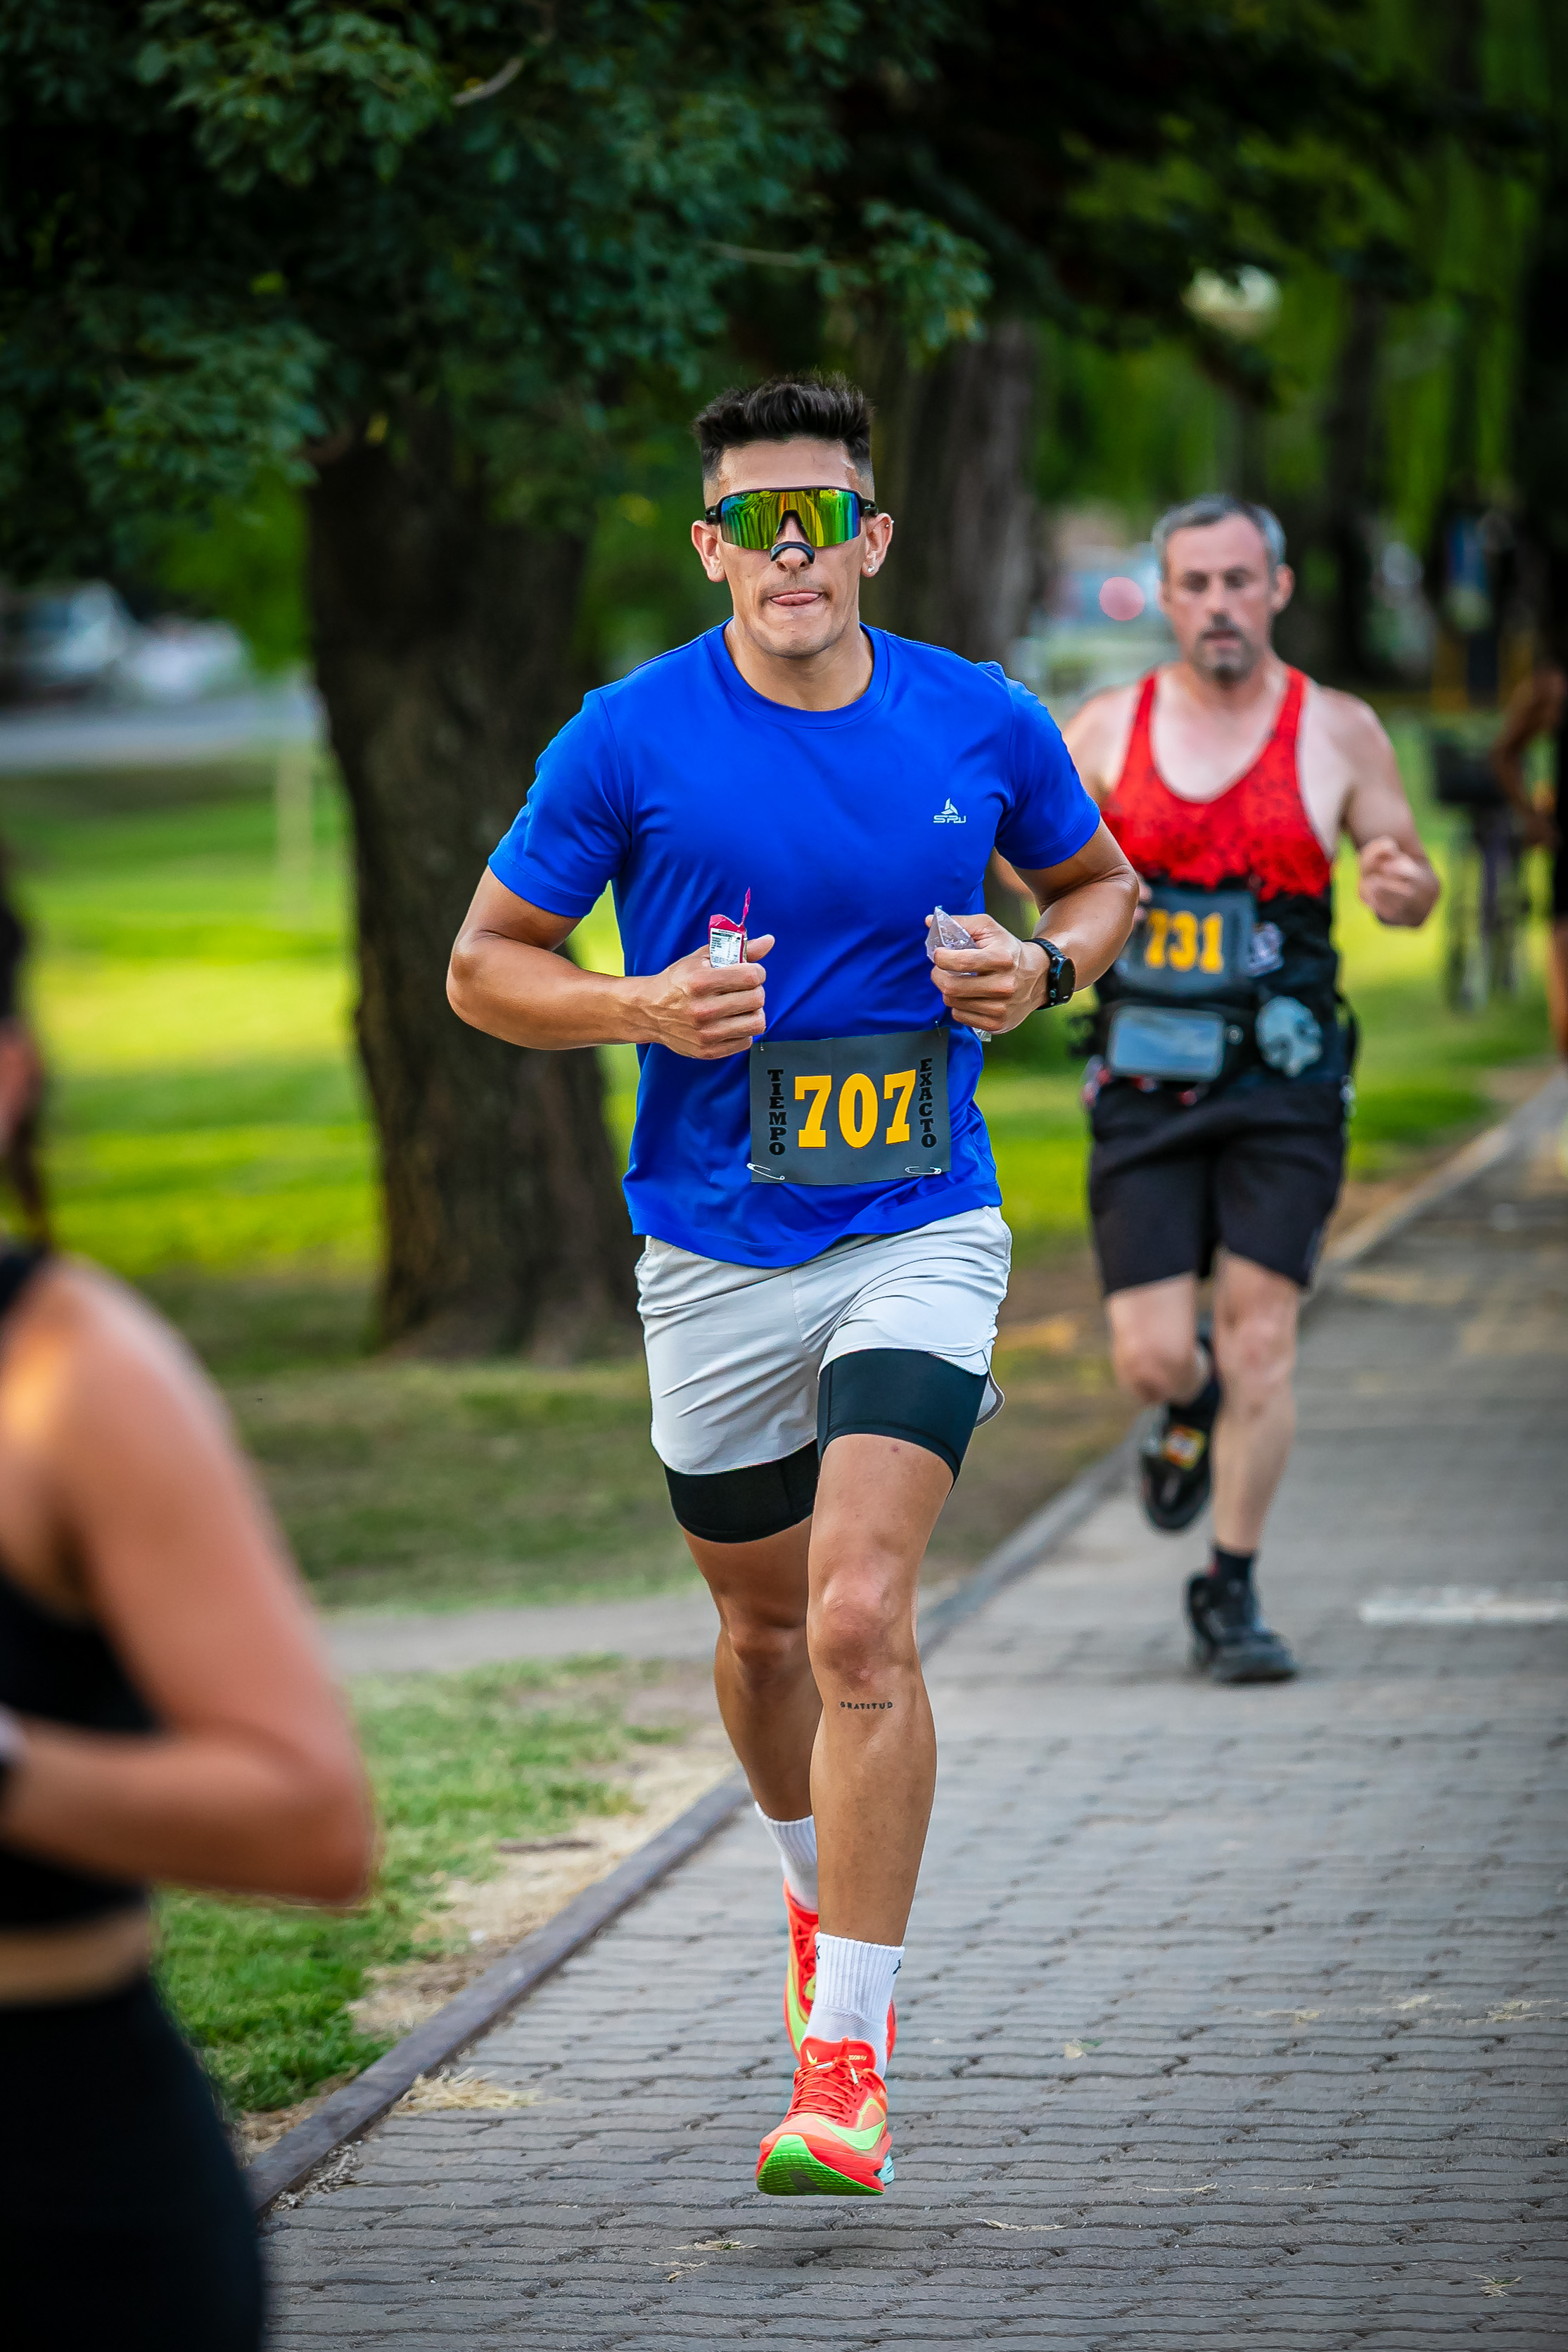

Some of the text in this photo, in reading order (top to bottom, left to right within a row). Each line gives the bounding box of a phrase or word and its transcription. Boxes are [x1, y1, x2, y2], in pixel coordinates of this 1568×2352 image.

[1146, 909, 1224, 974] 731
[767, 1069, 787, 1156] TIEMPO
[794, 1069, 917, 1148] 707
[918, 1057, 937, 1148] EXACTO
[840, 1701, 893, 1710] GRATITUD
